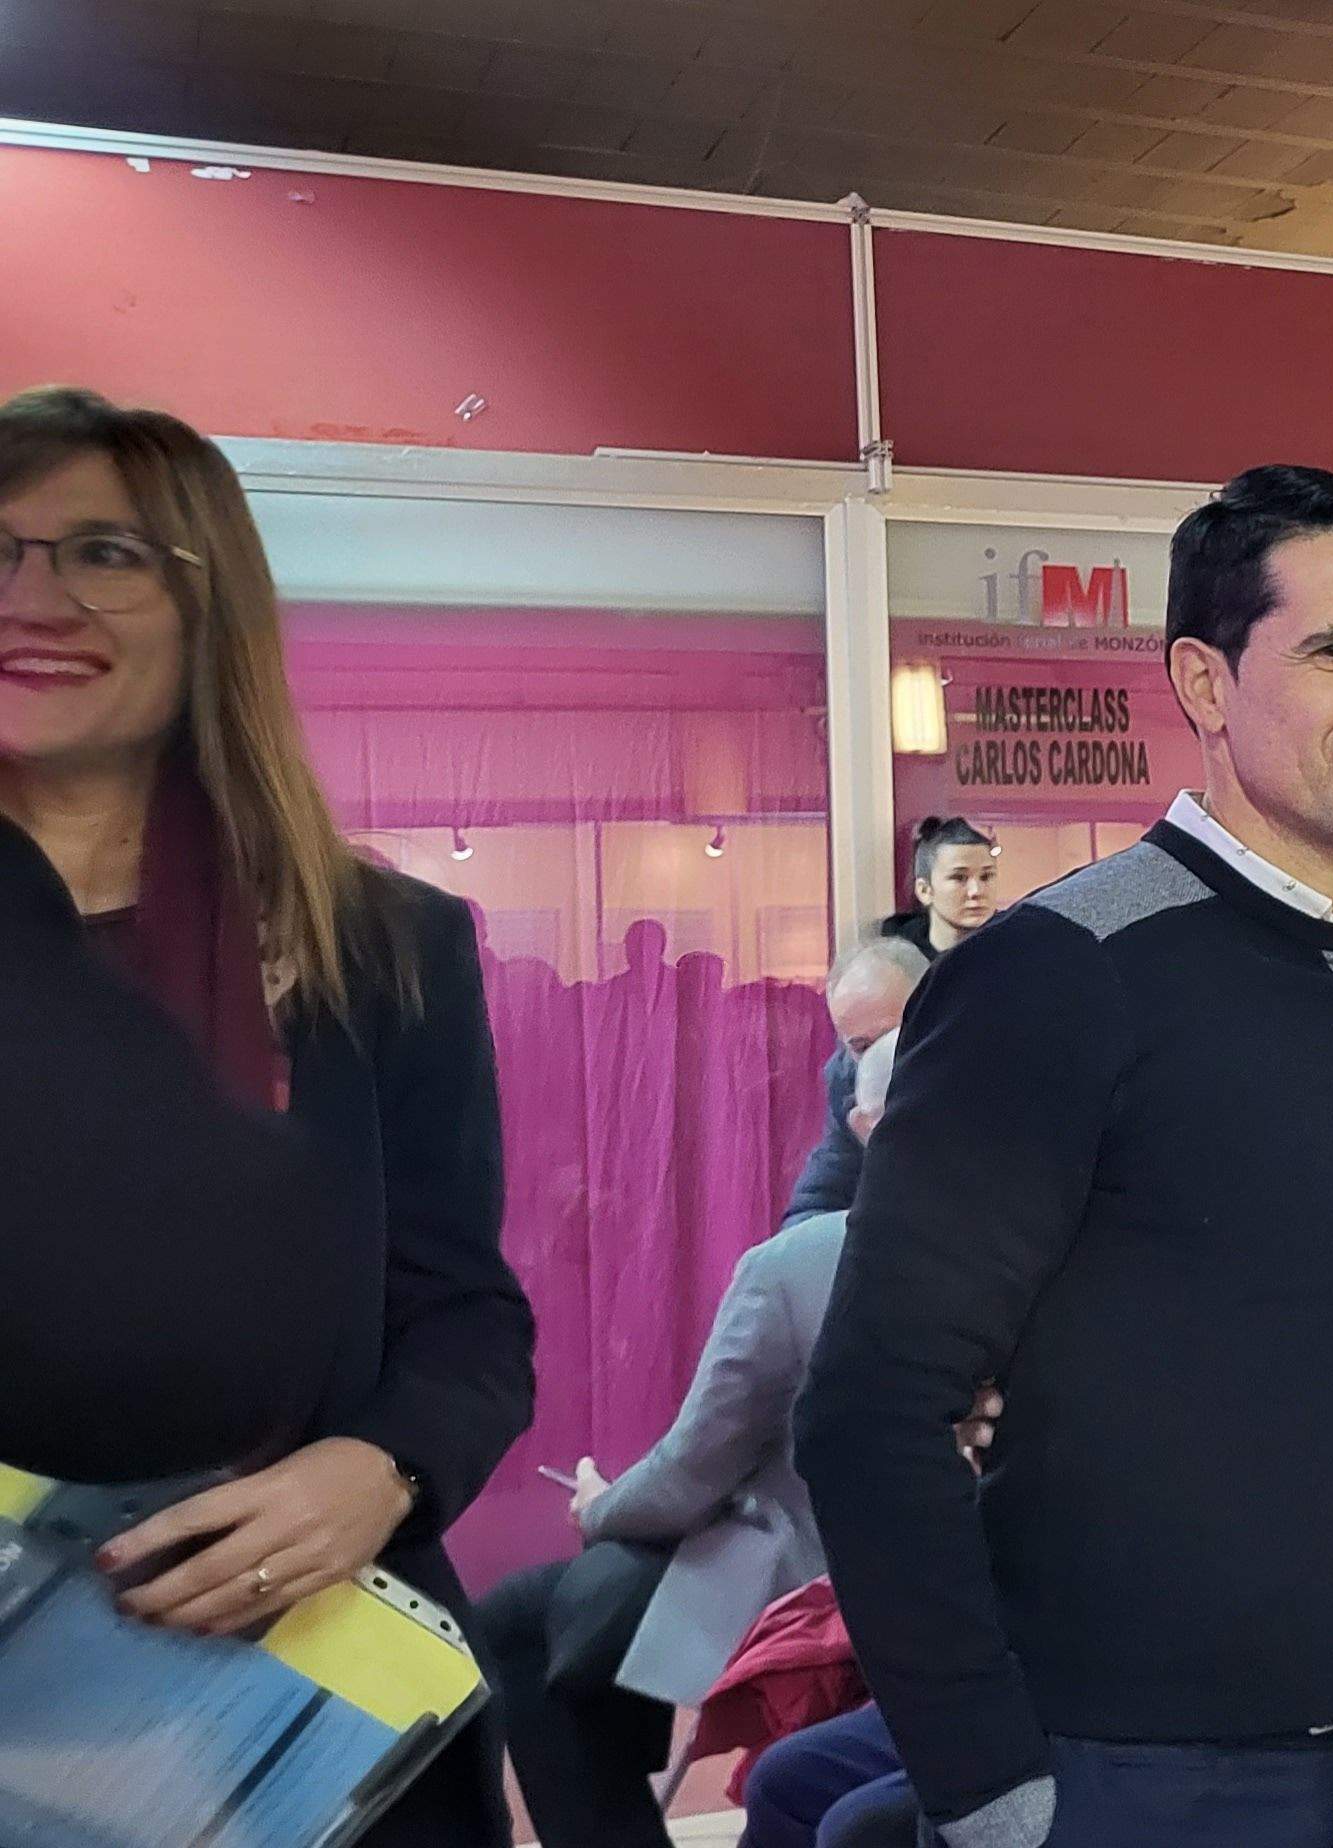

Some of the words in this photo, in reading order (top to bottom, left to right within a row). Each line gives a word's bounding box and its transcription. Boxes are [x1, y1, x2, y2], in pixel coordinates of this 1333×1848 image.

[918, 631, 1012, 648] institución
[976, 686, 1130, 733] MASTERCLASS
[956, 739, 1043, 785] CARLOS
[1049, 740, 1150, 785] CARDONA
